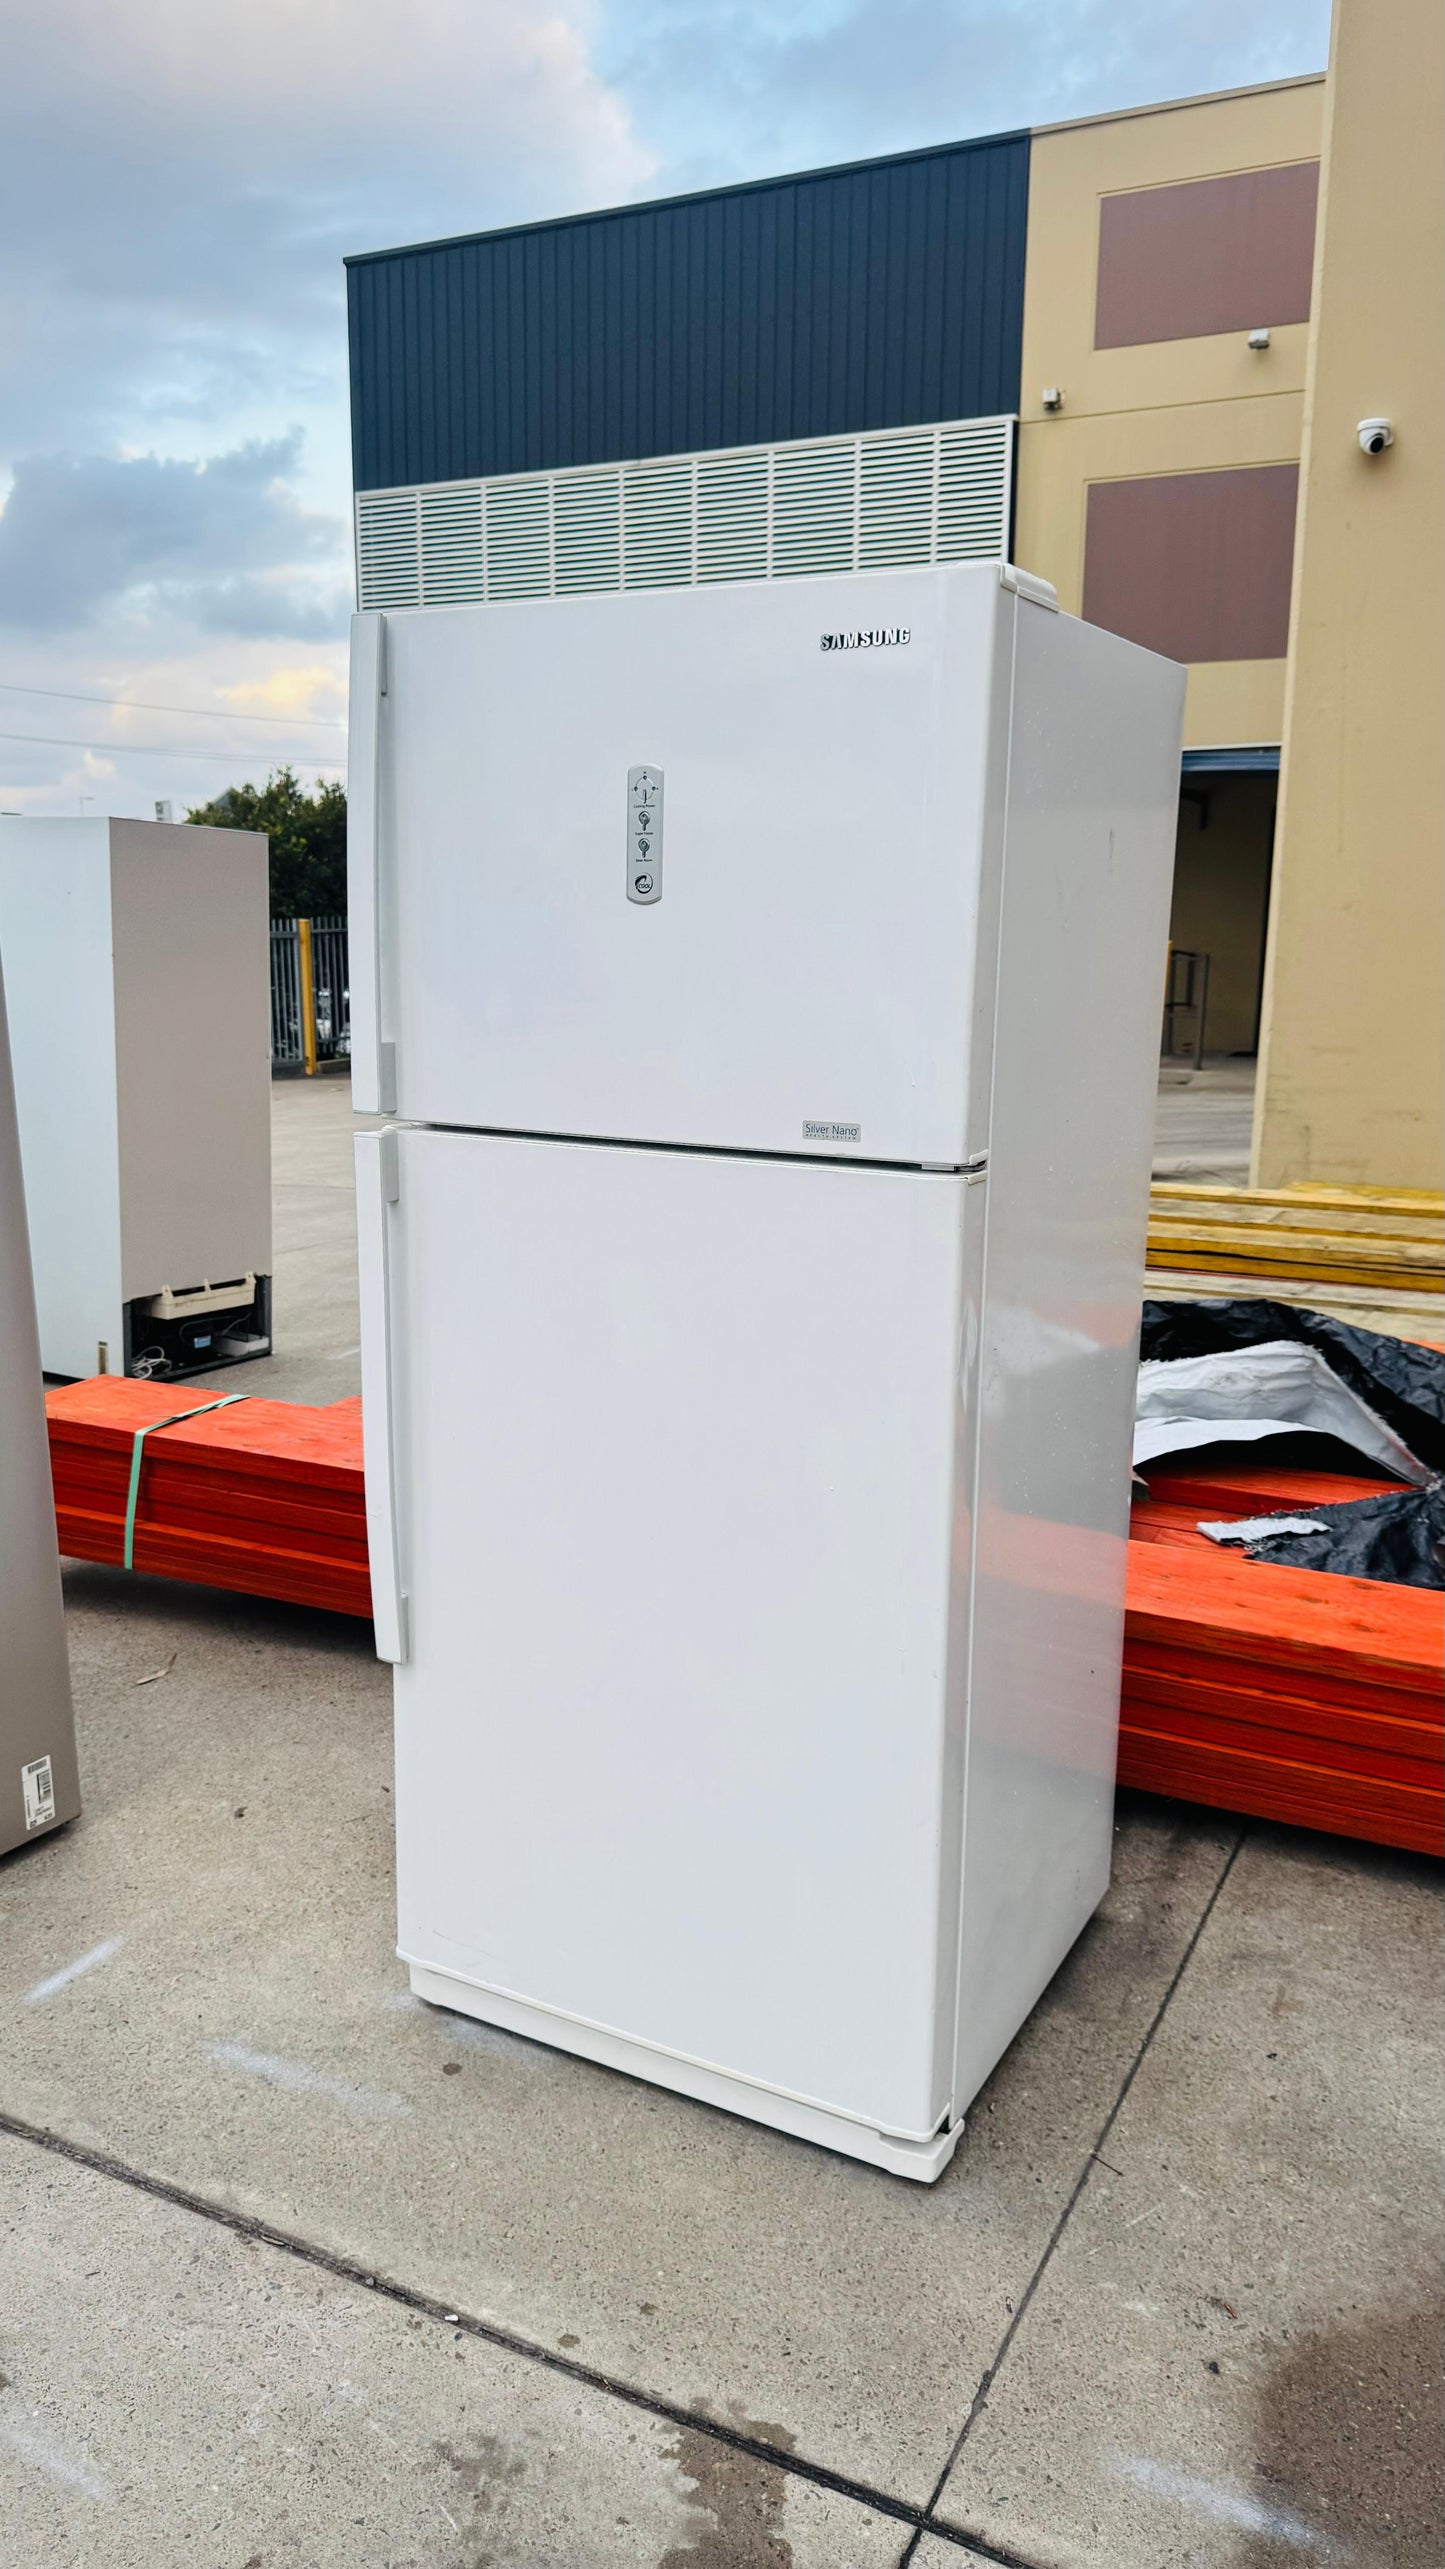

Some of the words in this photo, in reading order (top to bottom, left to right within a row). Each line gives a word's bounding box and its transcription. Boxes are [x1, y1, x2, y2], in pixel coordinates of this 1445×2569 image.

[820, 627, 910, 651] SAMSUNG
[805, 1123, 829, 1134] Silver
[832, 1125, 857, 1136] Nano
